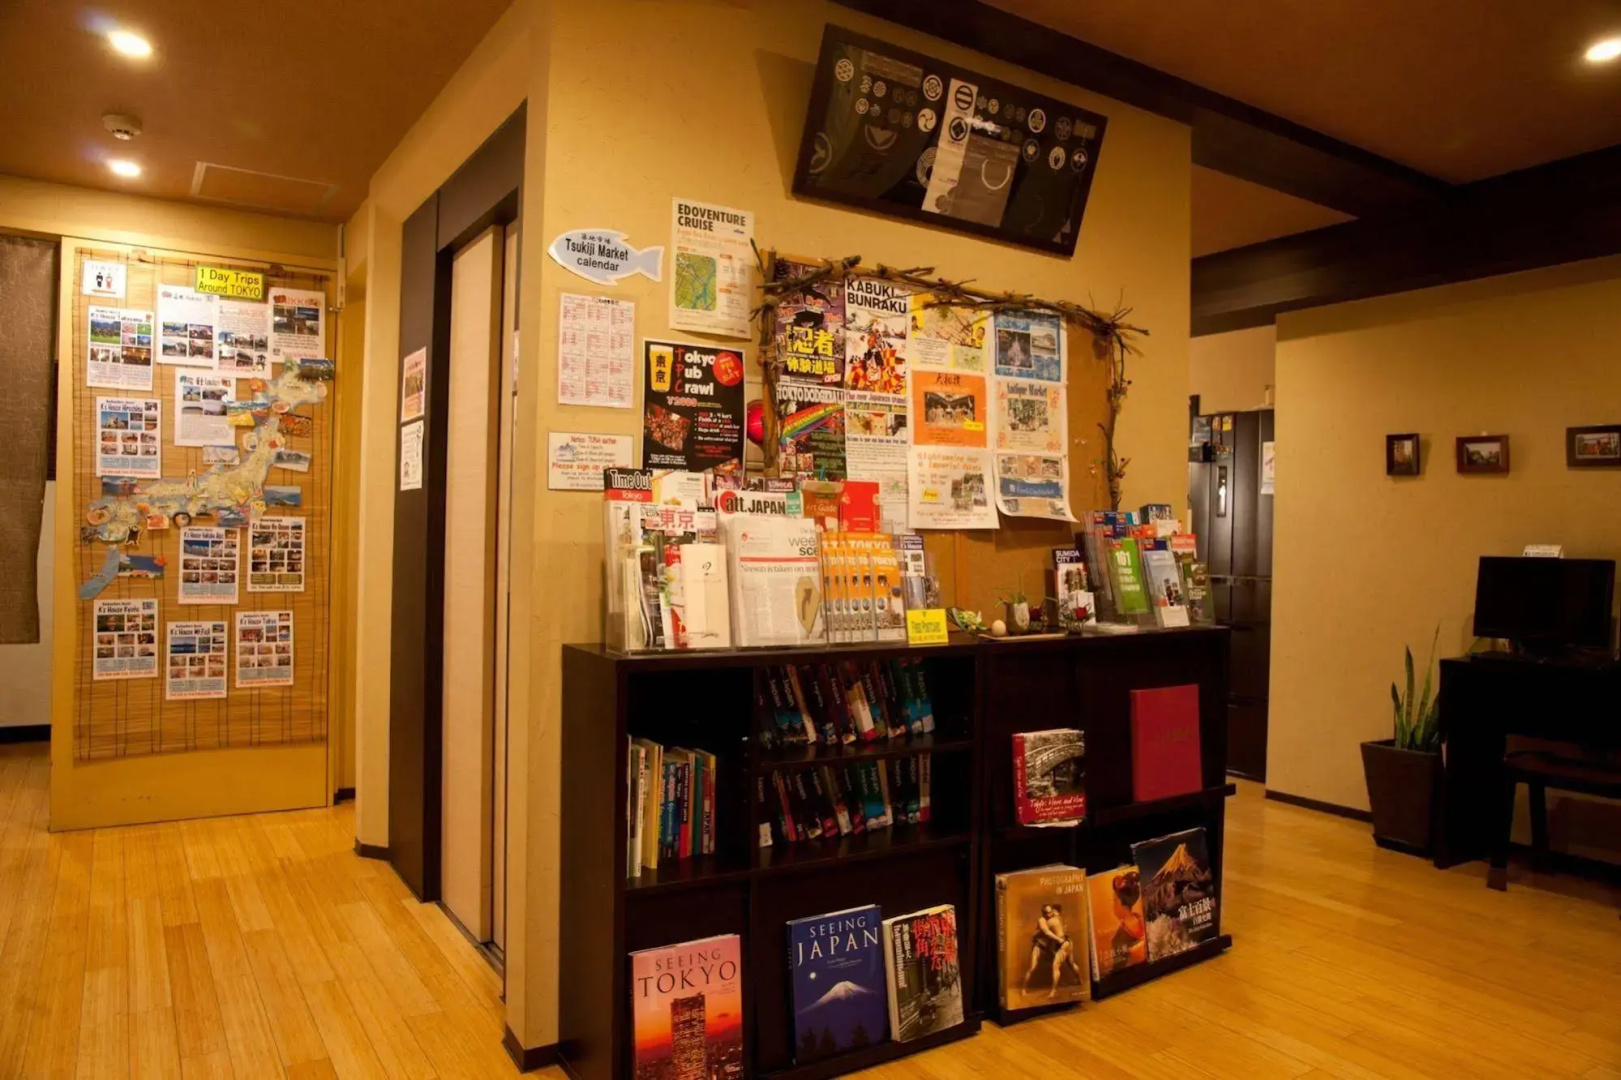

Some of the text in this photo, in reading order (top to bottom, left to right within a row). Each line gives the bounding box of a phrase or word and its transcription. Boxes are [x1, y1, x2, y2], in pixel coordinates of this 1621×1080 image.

[678, 204, 746, 226] EDOVENTURE
[678, 216, 714, 232] CRUISE
[566, 238, 628, 262] Tsukiji Market
[577, 257, 620, 272] calendar
[200, 269, 259, 286] 1 Day Trips
[198, 282, 260, 298] Around TOKYO
[847, 292, 907, 314] BUNRAKU
[655, 354, 666, 383] 東京
[610, 470, 652, 490] Time Out
[621, 490, 642, 500] Tokyo
[658, 508, 695, 530] 東京
[873, 556, 897, 566] TOKYO
[1064, 884, 1084, 894] JAPAN
[810, 916, 866, 938] SEEING
[797, 927, 878, 967] JAPAN
[655, 948, 721, 972] SEEING
[638, 960, 737, 998] TOKYO
